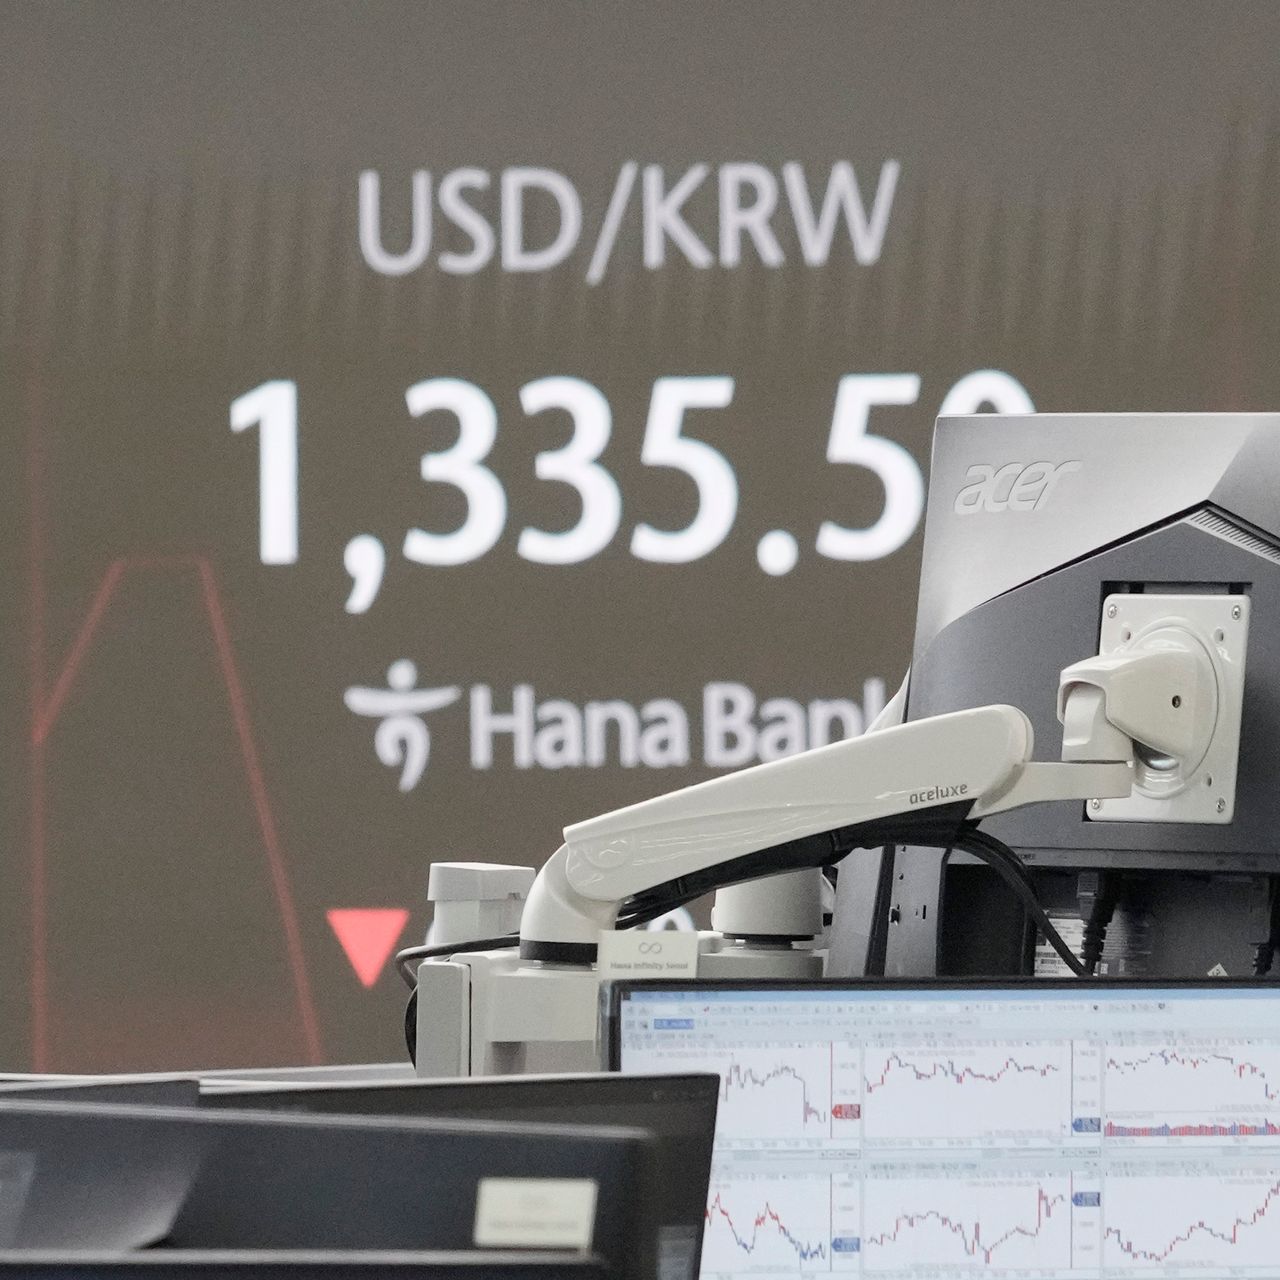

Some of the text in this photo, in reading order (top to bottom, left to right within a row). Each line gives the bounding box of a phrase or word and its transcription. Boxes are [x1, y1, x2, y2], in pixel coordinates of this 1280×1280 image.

[358, 160, 901, 285] USD/KRW
[230, 370, 1036, 615] 1,335.5
[953, 460, 1083, 515] acer
[469, 683, 690, 770] Hana
[909, 783, 968, 805] aceluxe
